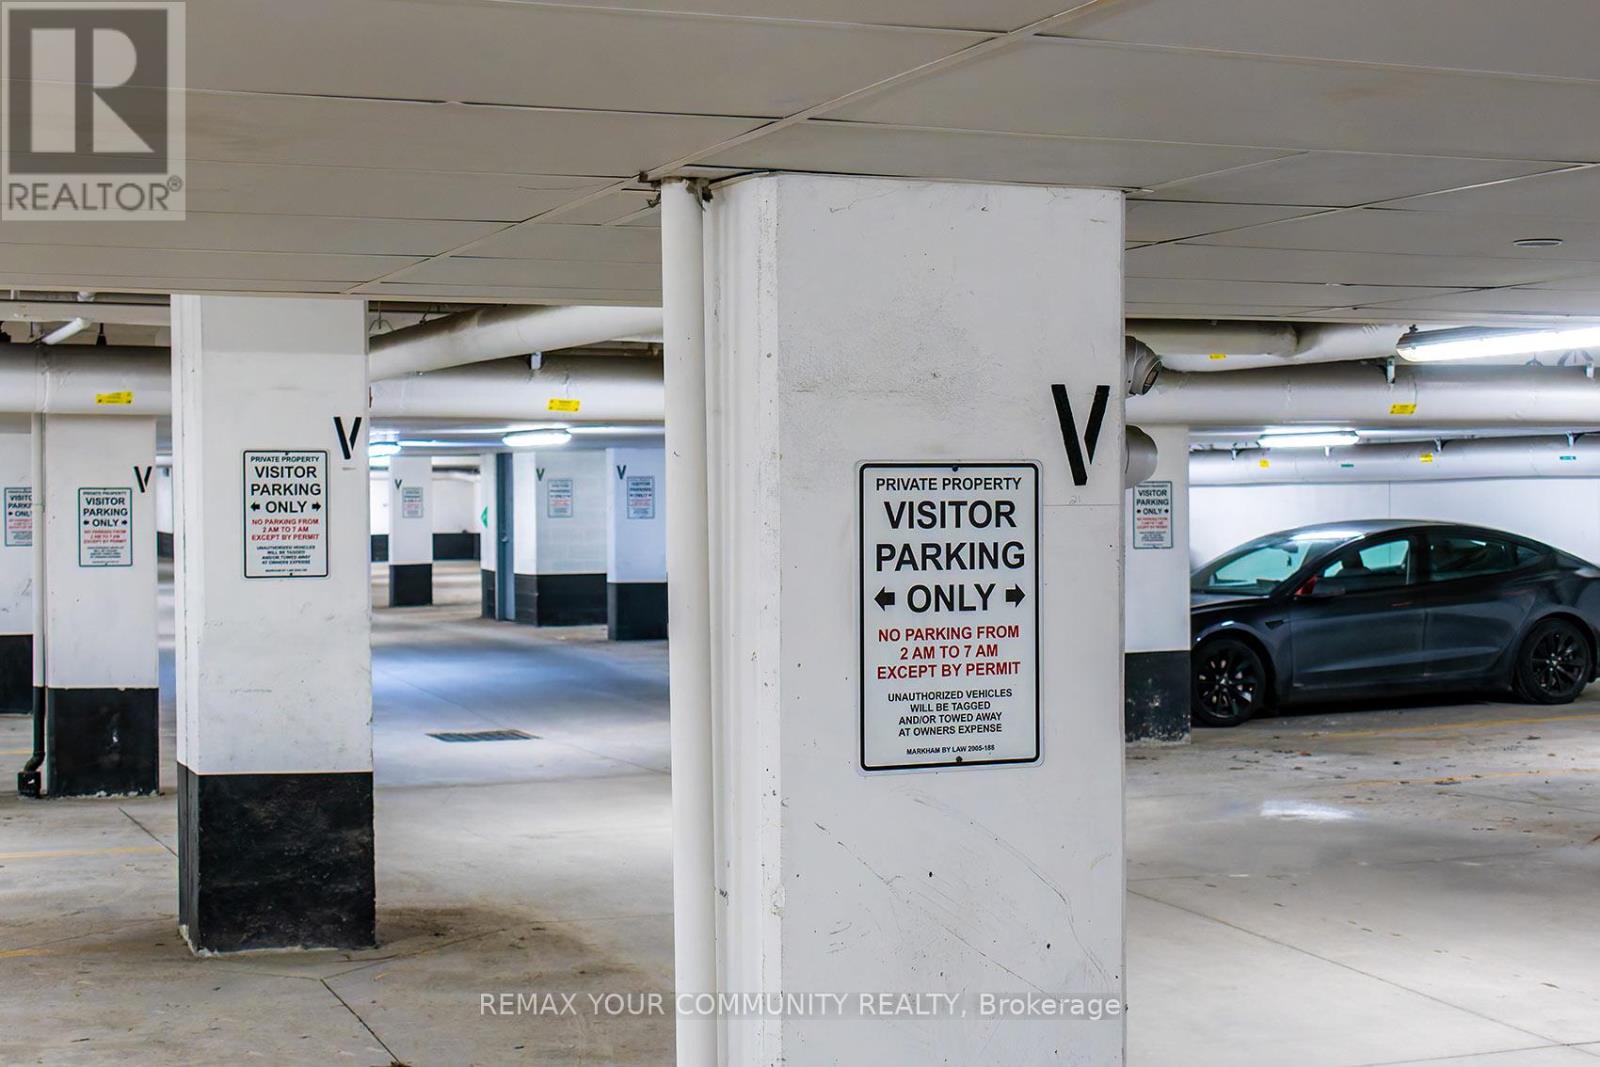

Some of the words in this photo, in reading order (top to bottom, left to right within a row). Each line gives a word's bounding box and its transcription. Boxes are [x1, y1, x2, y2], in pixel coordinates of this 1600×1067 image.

[333, 416, 362, 460] V
[1051, 384, 1110, 486] V
[254, 466, 317, 478] VISITOR
[134, 466, 152, 493] V
[876, 477, 938, 491] PRIVATE
[942, 476, 1022, 491] PROPERTY
[250, 483, 321, 496] PARKING
[85, 497, 125, 505] VISITOR
[265, 501, 307, 513] ONLY
[83, 508, 128, 516] PARKING
[883, 500, 1017, 529] VISITOR
[92, 519, 119, 527] ONLY
[876, 541, 1025, 572] PARKING
[907, 583, 996, 613] ONLY
[878, 628, 901, 642] NO
[905, 626, 972, 641] PARKING
[977, 625, 1019, 639] FROM
[900, 647, 909, 660] 2
[912, 646, 935, 660] AM
[939, 645, 960, 658] TO
[964, 644, 972, 658] 7
[975, 644, 998, 657] AM
[877, 664, 937, 679] EXCEPT
[941, 663, 962, 677] BY
[966, 661, 1021, 676] PERMIT
[888, 690, 964, 702] UNAUTHORIZED
[965, 688, 1013, 700] VEHICLES
[910, 703, 934, 713] WILL
[935, 702, 949, 712] BE
[951, 700, 991, 711] TAGGED
[898, 715, 936, 726] AND/OR
[939, 713, 974, 724] TOWED
[975, 712, 1003, 722] AWAY
[898, 727, 911, 737] AT
[913, 725, 956, 737] OWNERS
[958, 723, 1003, 735] EXPENSE
[906, 747, 940, 755] MARKHAM
[941, 746, 952, 754] BY
